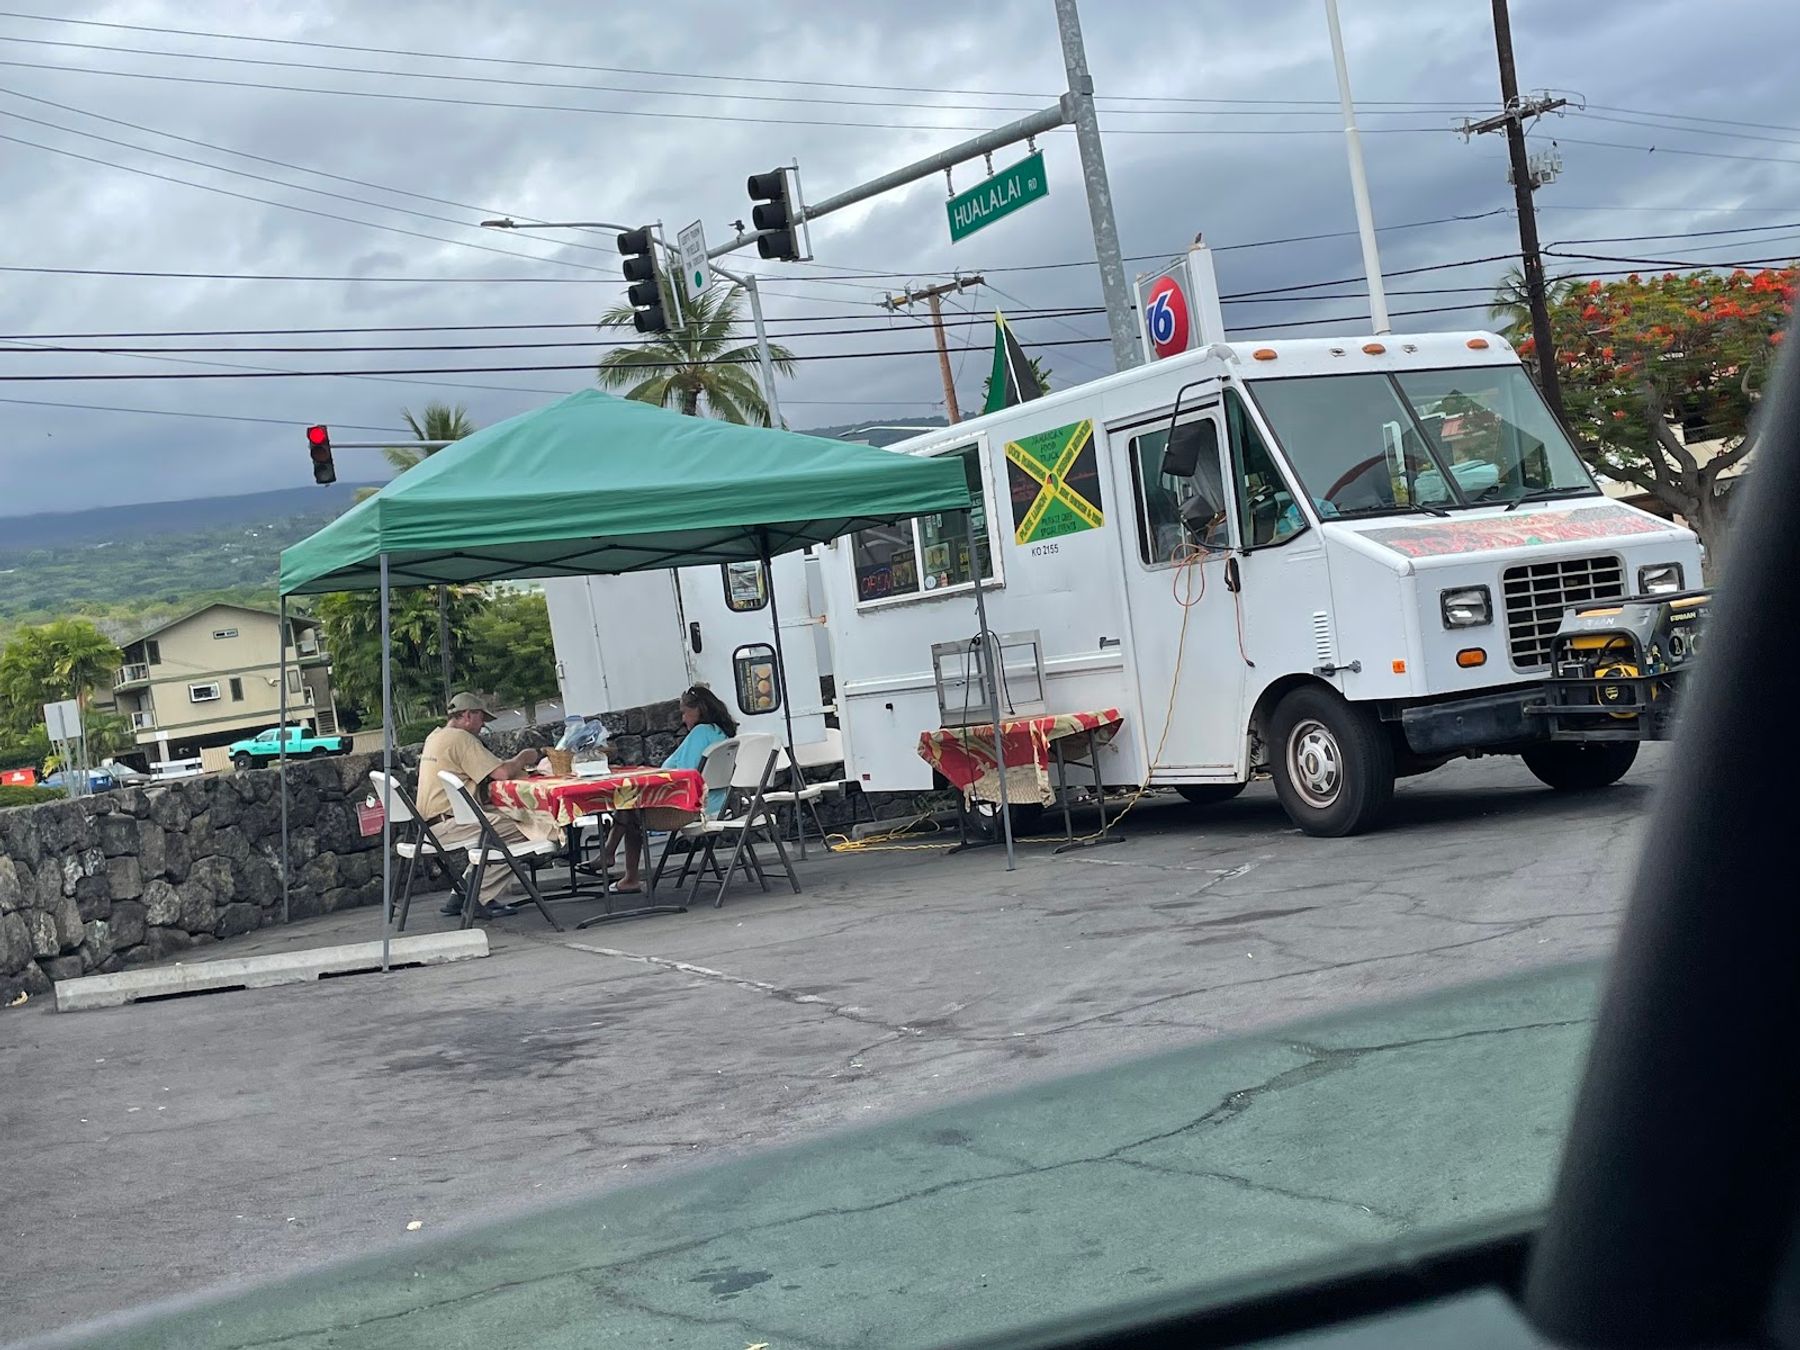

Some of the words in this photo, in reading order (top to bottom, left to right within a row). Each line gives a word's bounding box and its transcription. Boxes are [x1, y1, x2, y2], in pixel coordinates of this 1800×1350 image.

[954, 175, 1021, 230] HUALALAI
[1028, 177, 1038, 192] RD
[1145, 289, 1175, 349] 76
[1041, 442, 1056, 453] FOOD
[1019, 516, 1033, 541] PLATE
[1031, 492, 1048, 520] LUNCH
[1043, 543, 1059, 555] 2155
[861, 572, 891, 594] OPEN
